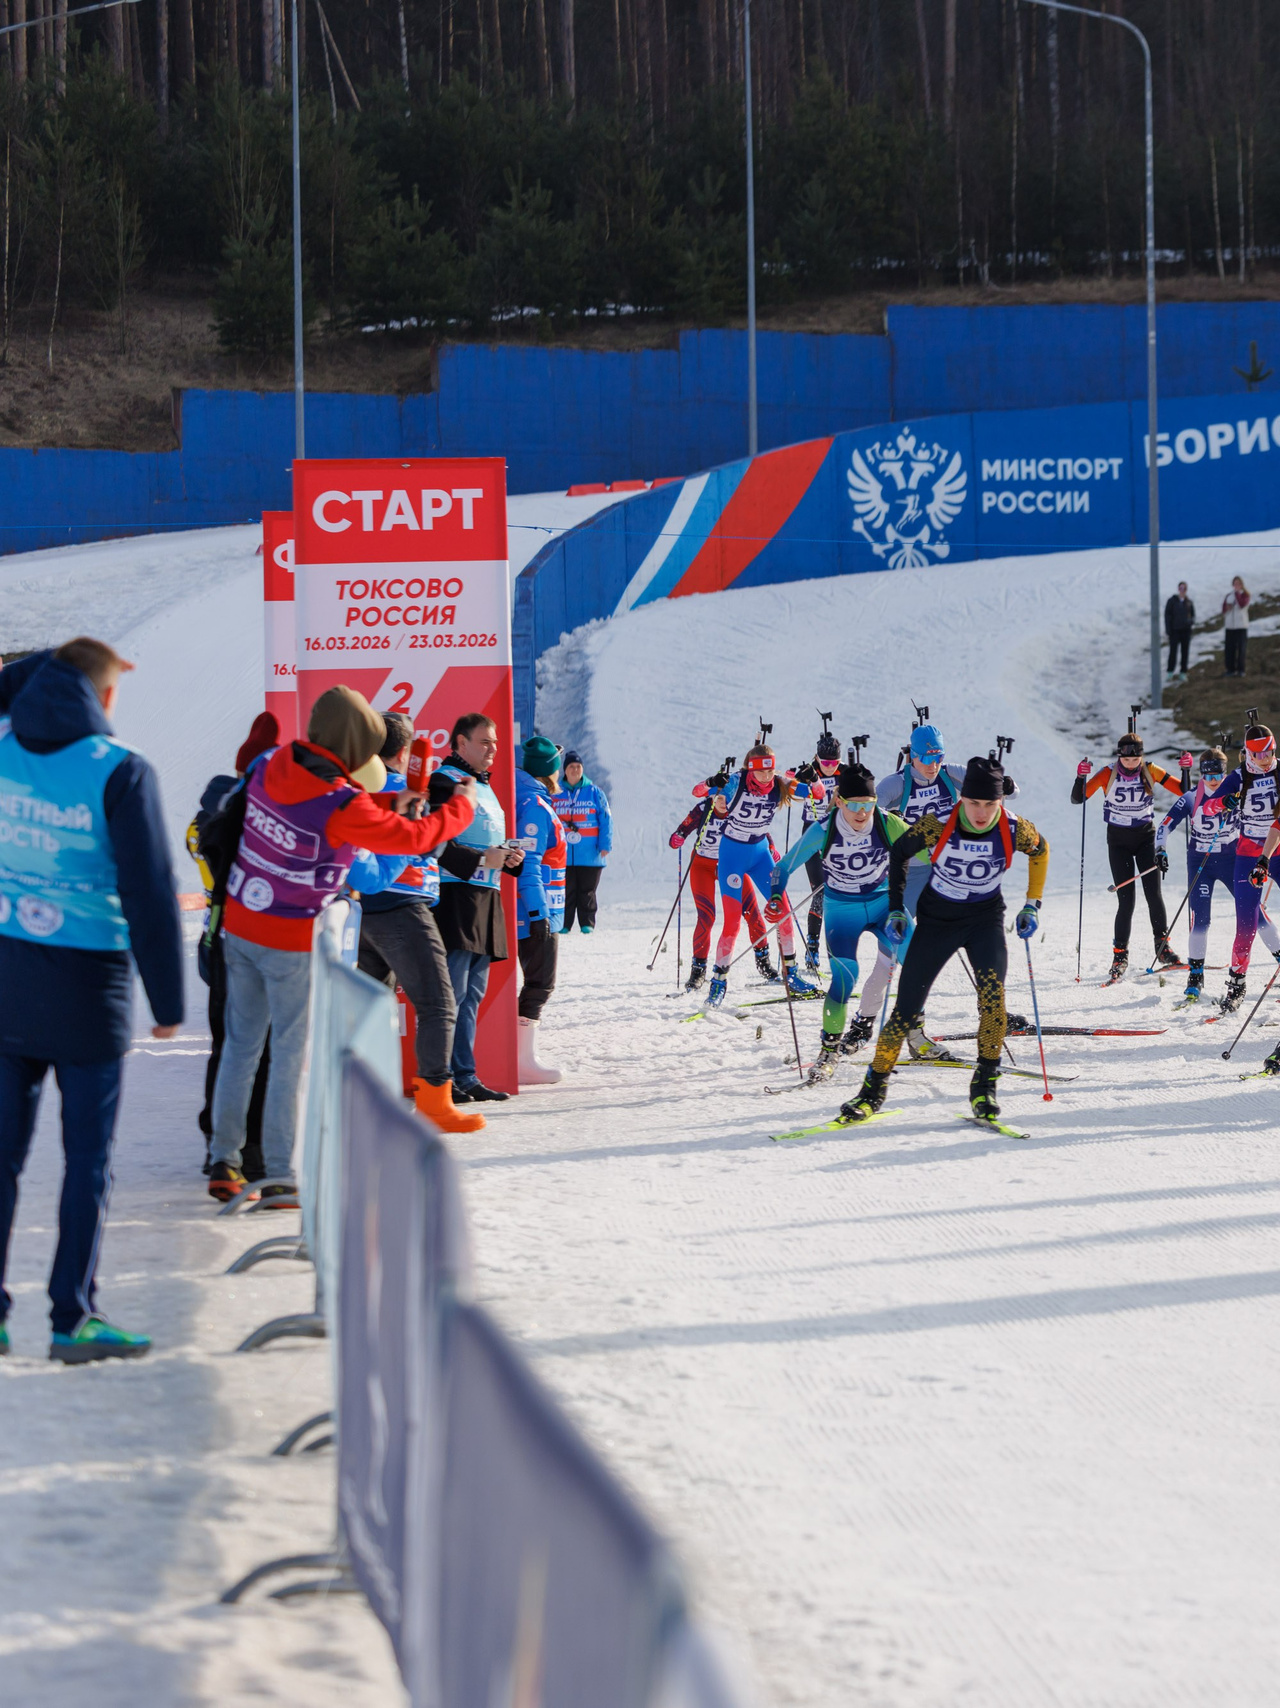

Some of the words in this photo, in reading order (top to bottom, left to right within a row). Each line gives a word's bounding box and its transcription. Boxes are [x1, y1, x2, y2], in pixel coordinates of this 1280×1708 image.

[981, 457, 1123, 482] МИНСПОРТ
[312, 488, 484, 533] СТАРТ
[982, 490, 1090, 514] РОССИИ
[336, 577, 464, 600] ТОКСОВО
[345, 605, 457, 627] РОССИЯ
[304, 635, 391, 651] 16.03.2026
[409, 633, 498, 649] 23.03.2026
[387, 682, 414, 714] 2
[918, 788, 937, 798] VEKA
[1255, 778, 1274, 788] VEKA
[1114, 787, 1146, 803] 517
[738, 800, 775, 819] 513
[246, 801, 297, 850] PRESS
[963, 843, 989, 853] VEKA
